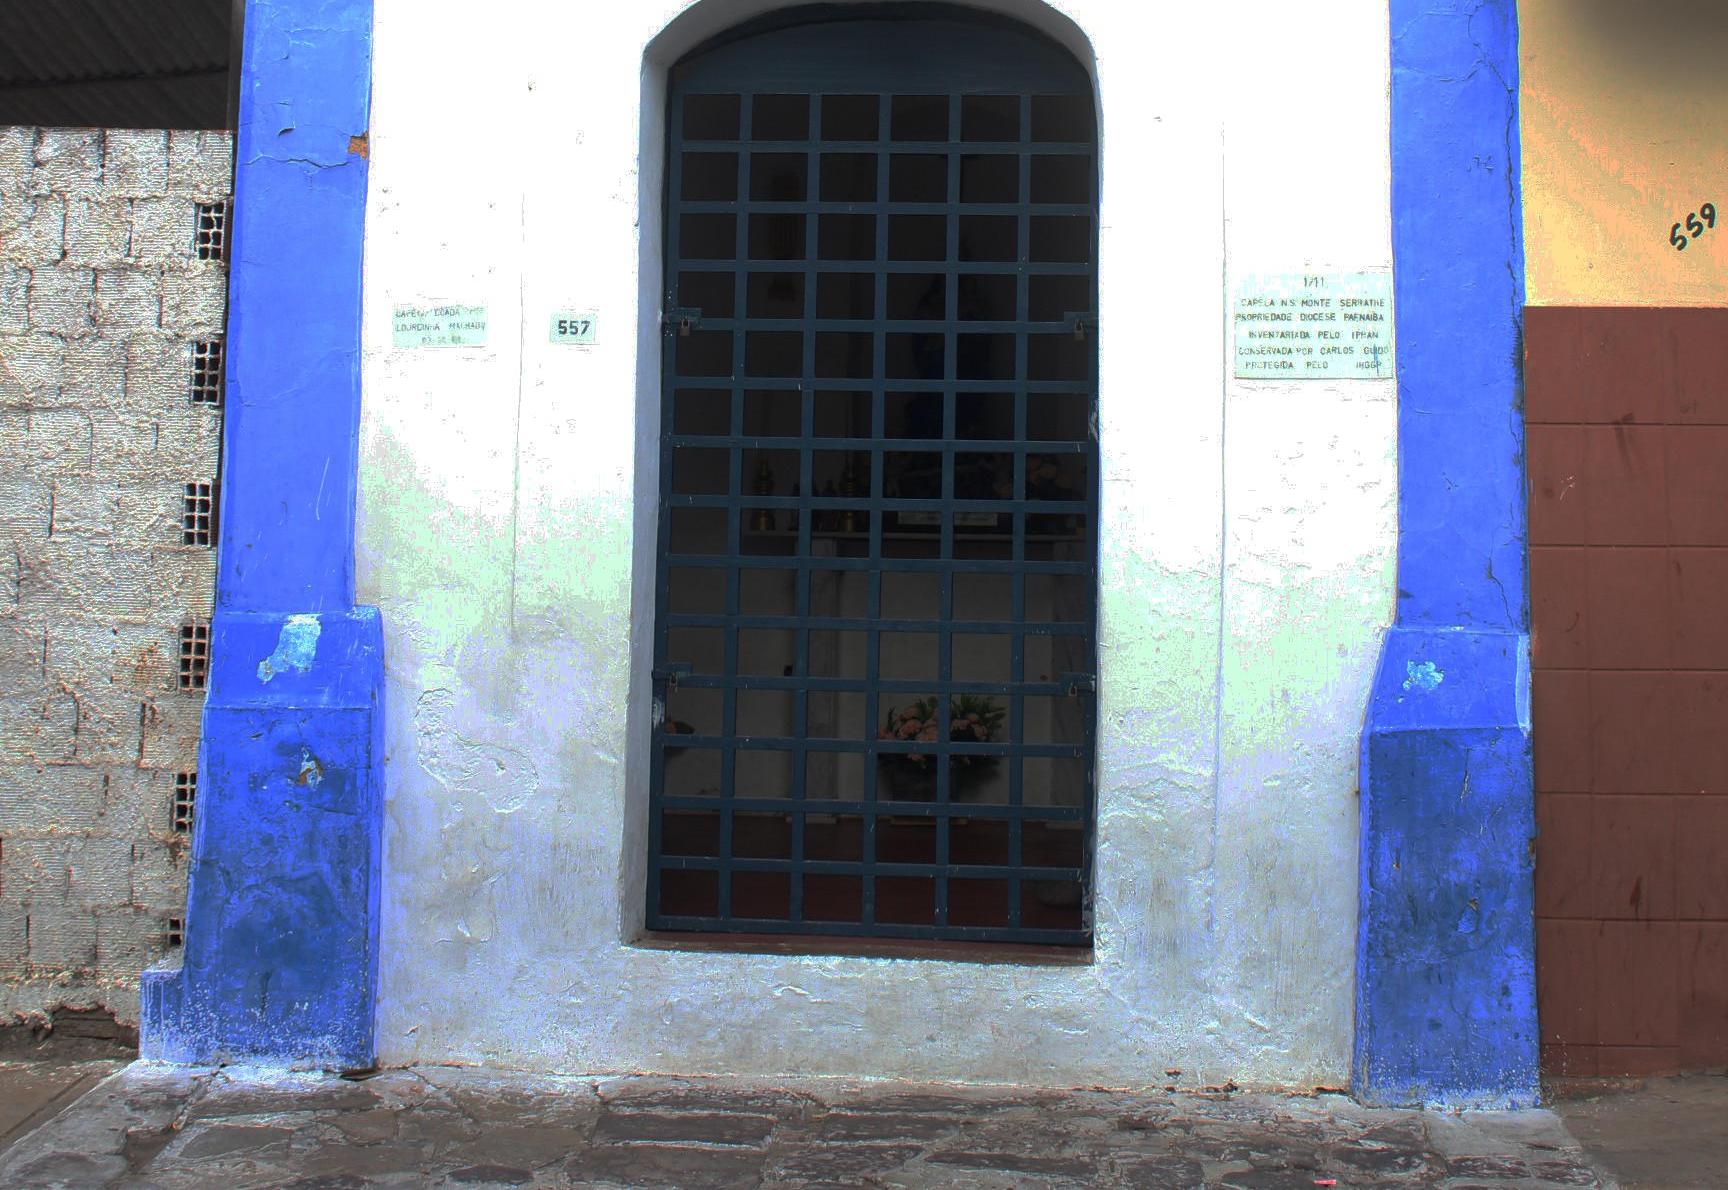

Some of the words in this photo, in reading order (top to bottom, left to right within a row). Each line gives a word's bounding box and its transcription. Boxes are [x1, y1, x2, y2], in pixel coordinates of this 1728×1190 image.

[1669, 202, 1717, 251] 559
[1240, 298, 1275, 308] CAPELA
[1301, 298, 1331, 308] MONTE
[1235, 312, 1293, 322] PROPRIEDADE
[1299, 312, 1336, 322] DIOCESE
[557, 319, 591, 336] 557
[1248, 330, 1311, 340] INVENTARIADA
[1317, 330, 1341, 340] PELO
[1351, 330, 1379, 340] IPHAN
[1238, 346, 1293, 356] CONSERVADA
[1296, 346, 1313, 356] POR
[1319, 345, 1355, 355] CARLOS
[1363, 345, 1389, 355] GUIDO
[1245, 360, 1294, 370] PROTEGIDA
[1306, 360, 1329, 370] PELO
